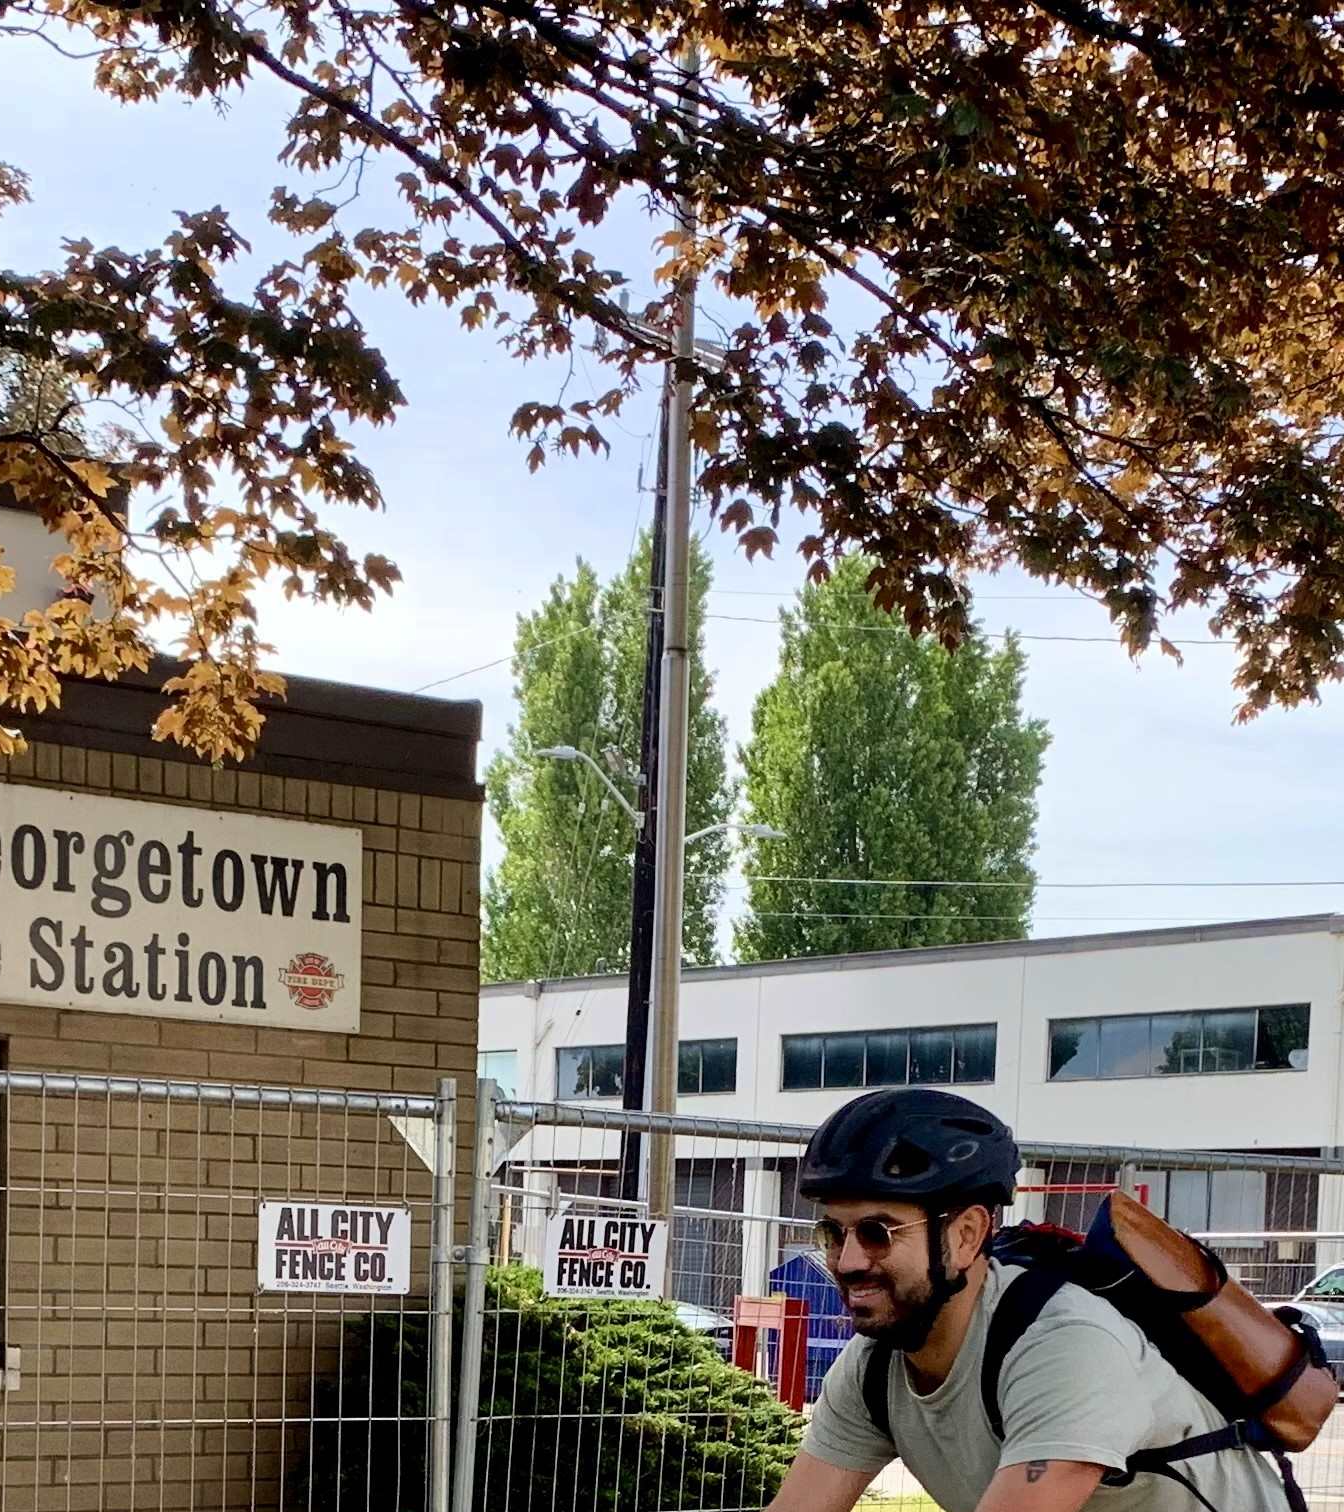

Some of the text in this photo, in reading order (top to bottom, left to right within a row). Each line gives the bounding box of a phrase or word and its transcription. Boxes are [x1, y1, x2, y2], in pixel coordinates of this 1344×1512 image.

[28, 916, 268, 1010] Station
[275, 1207, 395, 1245] ALL CITY
[559, 1218, 656, 1254] ALL CITY
[275, 1248, 393, 1283] FENCE CO.
[557, 1257, 651, 1290] FENCE CO.
